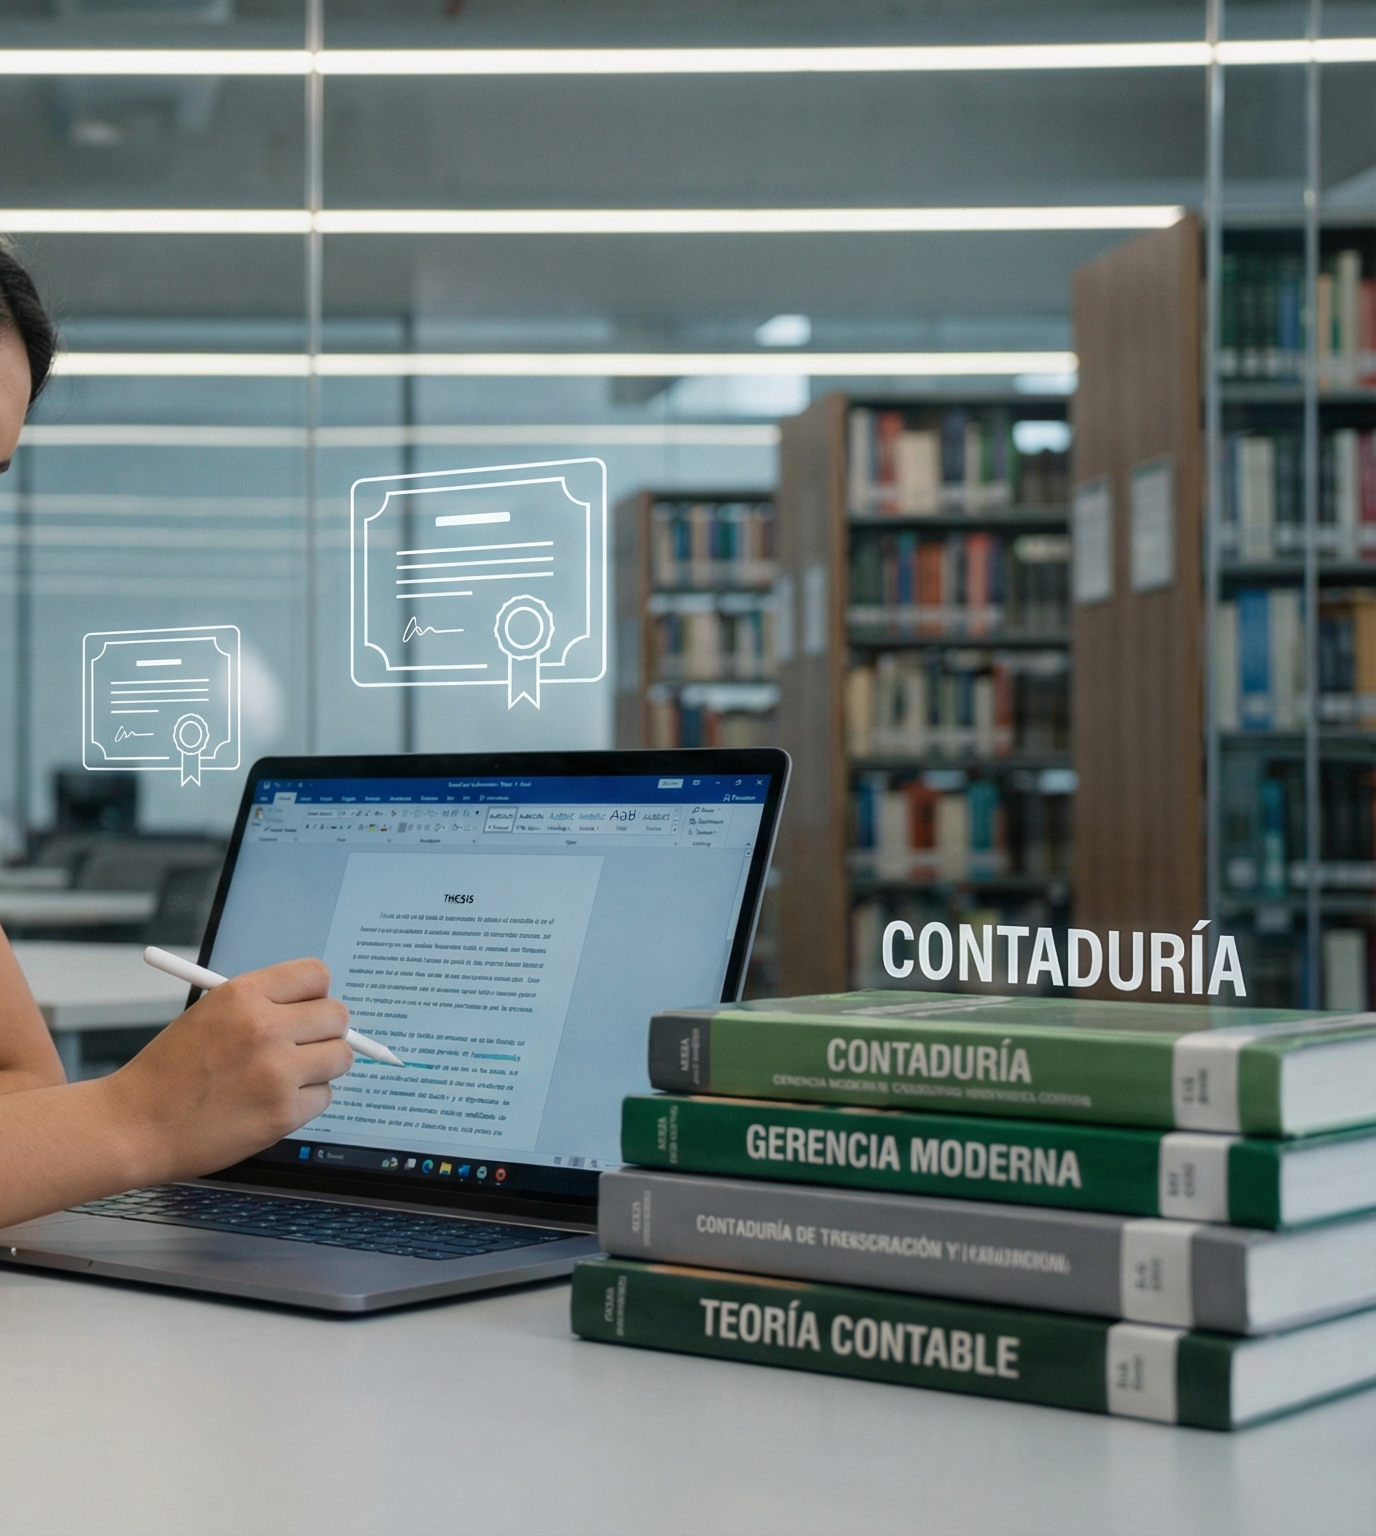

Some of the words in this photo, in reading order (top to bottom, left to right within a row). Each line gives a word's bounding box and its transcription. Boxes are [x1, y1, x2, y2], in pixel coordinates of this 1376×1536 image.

[442, 893, 474, 904] THESIS
[827, 1038, 1032, 1085] CONTADURÍA
[745, 1123, 901, 1173] GERENCIA
[910, 1136, 1082, 1188] MODERNA
[696, 1214, 793, 1242] CONTADURÍA
[795, 1225, 817, 1245] DE
[699, 1299, 821, 1352] TEORÍA
[830, 1313, 1022, 1380] CONTABLE
